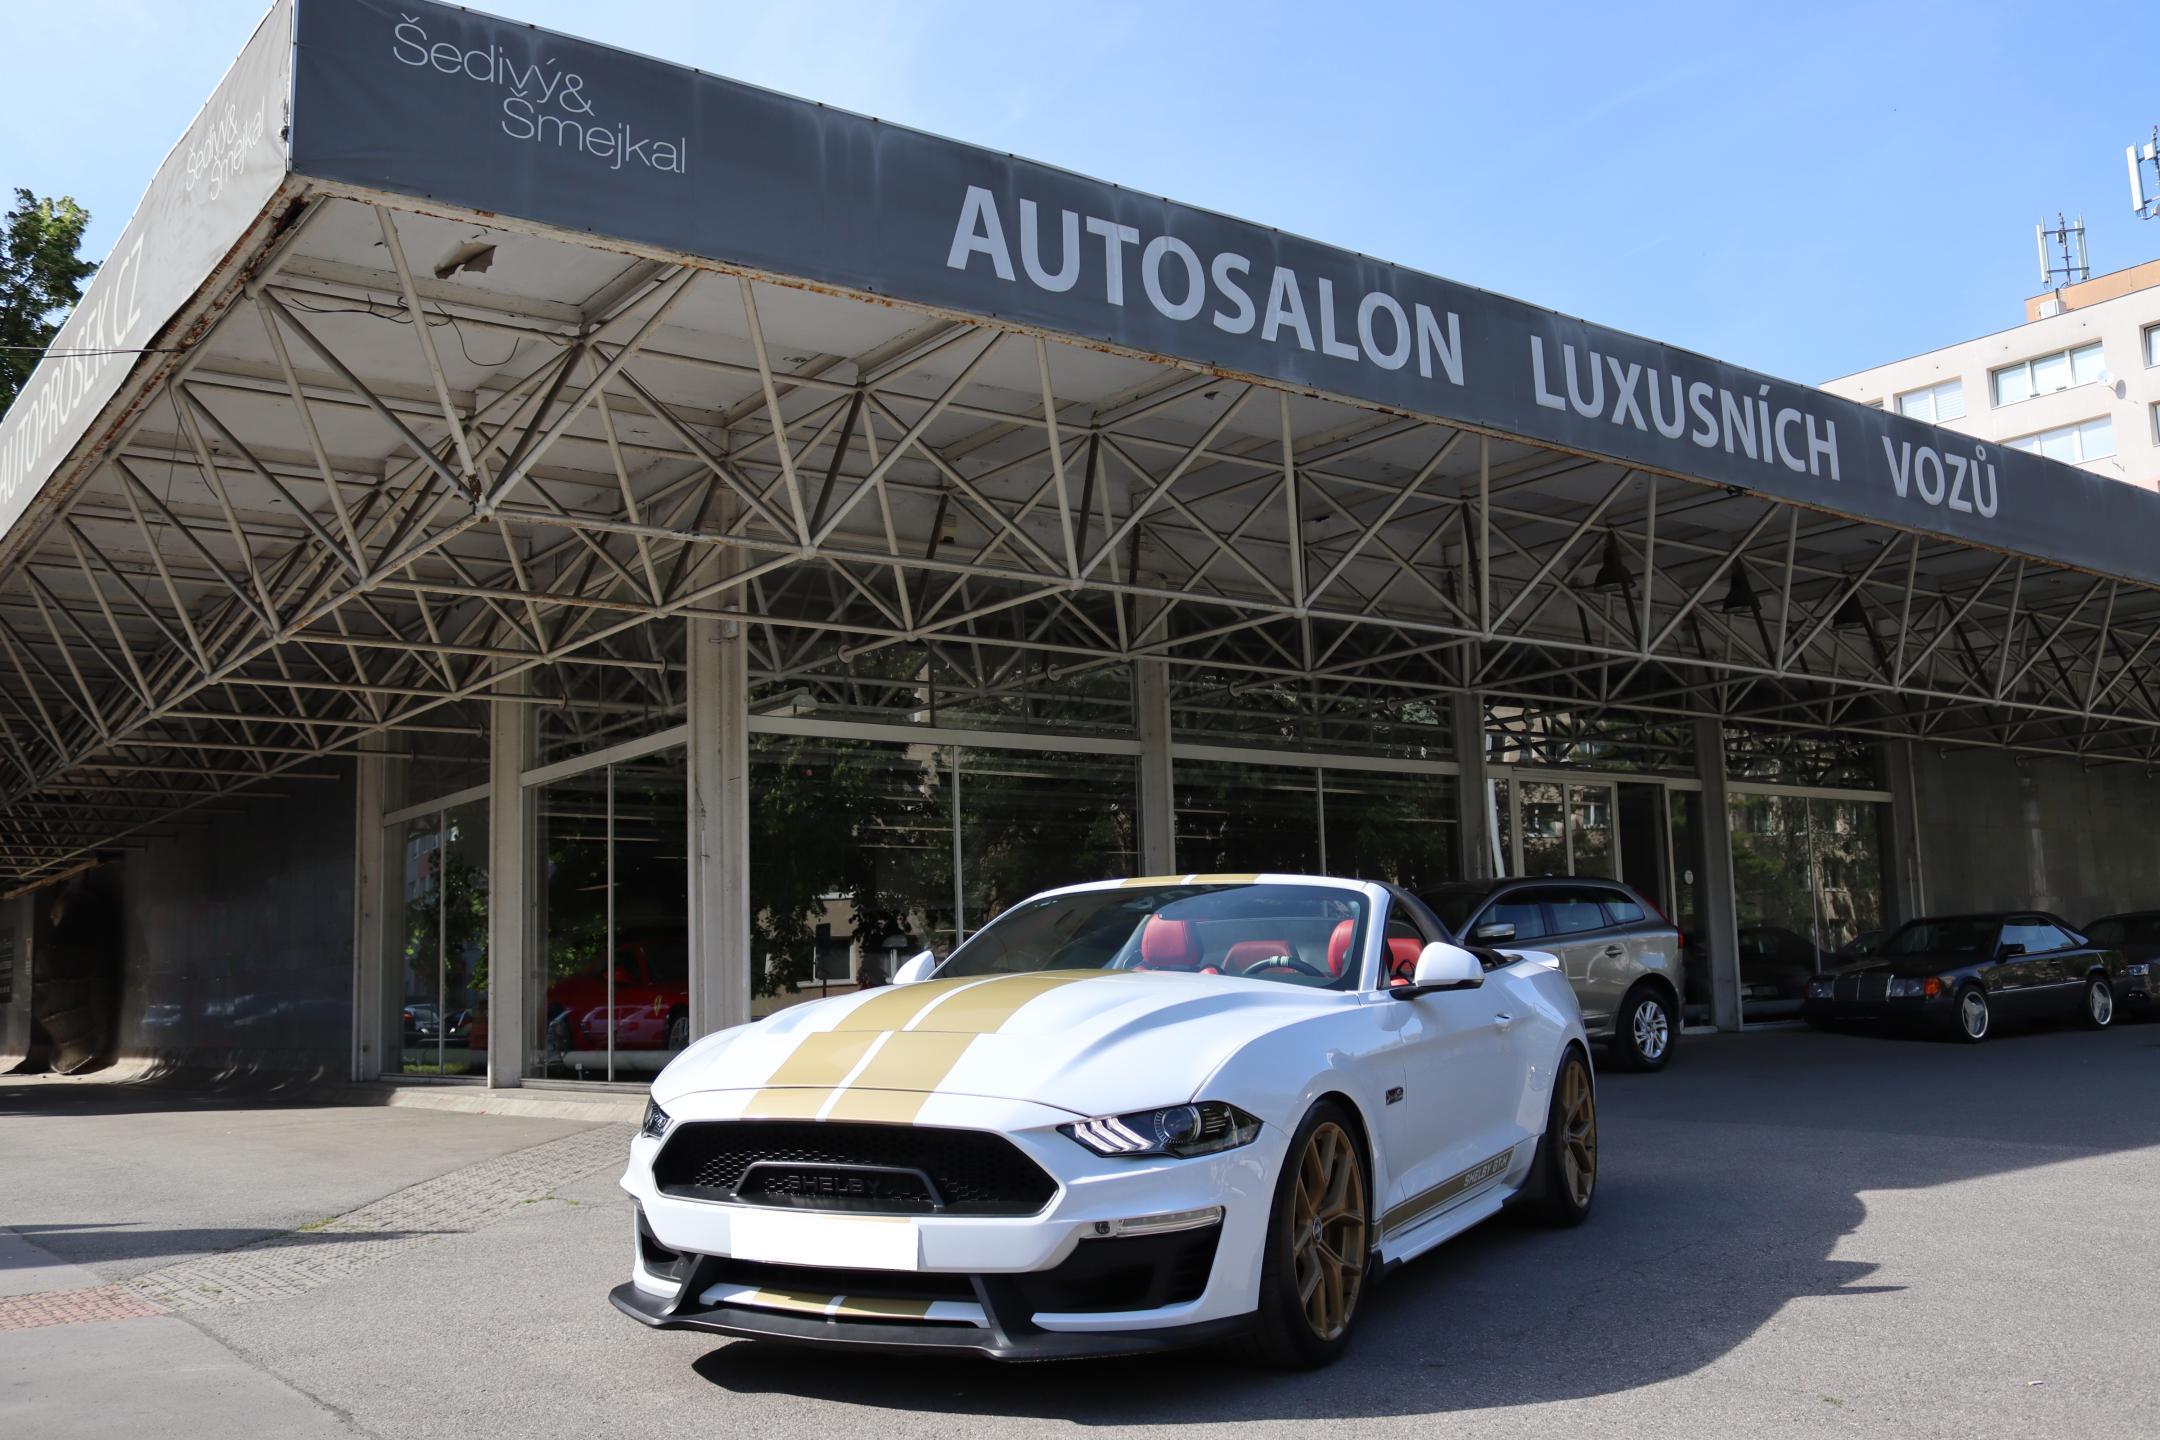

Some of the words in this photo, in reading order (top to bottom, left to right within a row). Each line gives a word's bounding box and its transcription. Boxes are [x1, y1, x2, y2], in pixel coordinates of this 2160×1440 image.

[210, 95, 265, 201] Šmejkal
[501, 86, 687, 175] Šmejkal
[0, 231, 144, 505] AUTOPROSEK.CZ
[946, 184, 1465, 387] AUTOSALON
[1529, 334, 1841, 481] LUXUSNÍCH
[1881, 435, 1999, 519] VOZŮ
[787, 1175, 881, 1197] SHELBY
